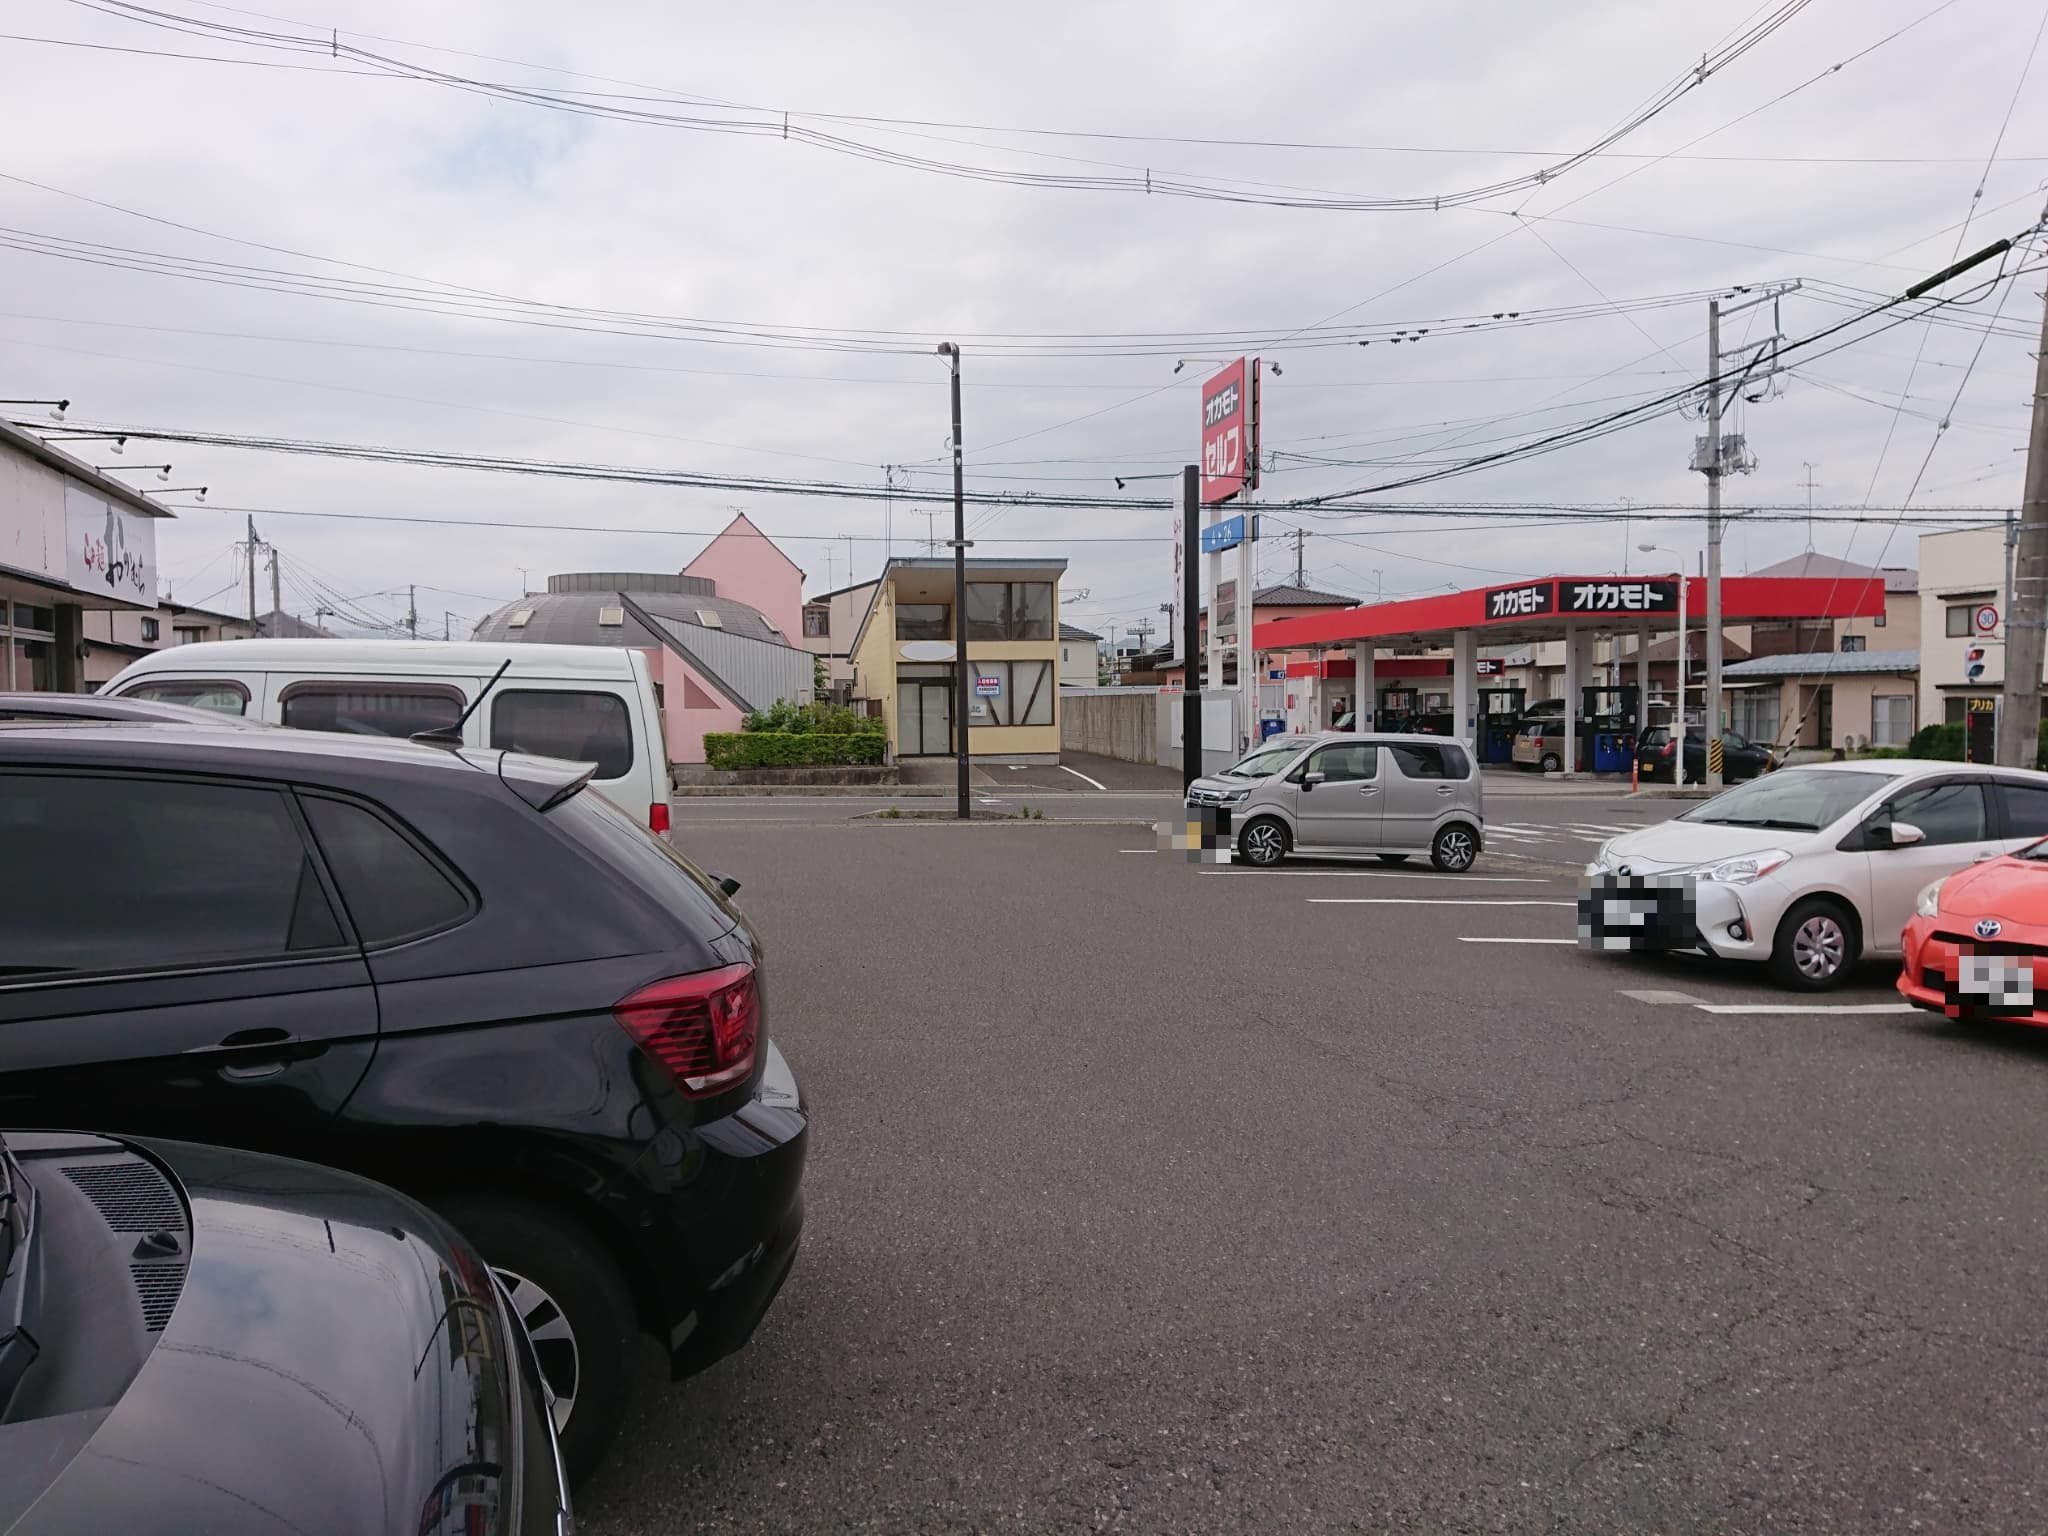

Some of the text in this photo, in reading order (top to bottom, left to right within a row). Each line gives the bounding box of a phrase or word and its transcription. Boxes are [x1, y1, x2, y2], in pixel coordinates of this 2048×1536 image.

[1206, 386, 1239, 426] オカモト
[1205, 426, 1239, 483] セルフ
[1493, 584, 1663, 616] オカモト オカモト
[1981, 613, 1993, 625] 30
[1476, 661, 1497, 673] モト
